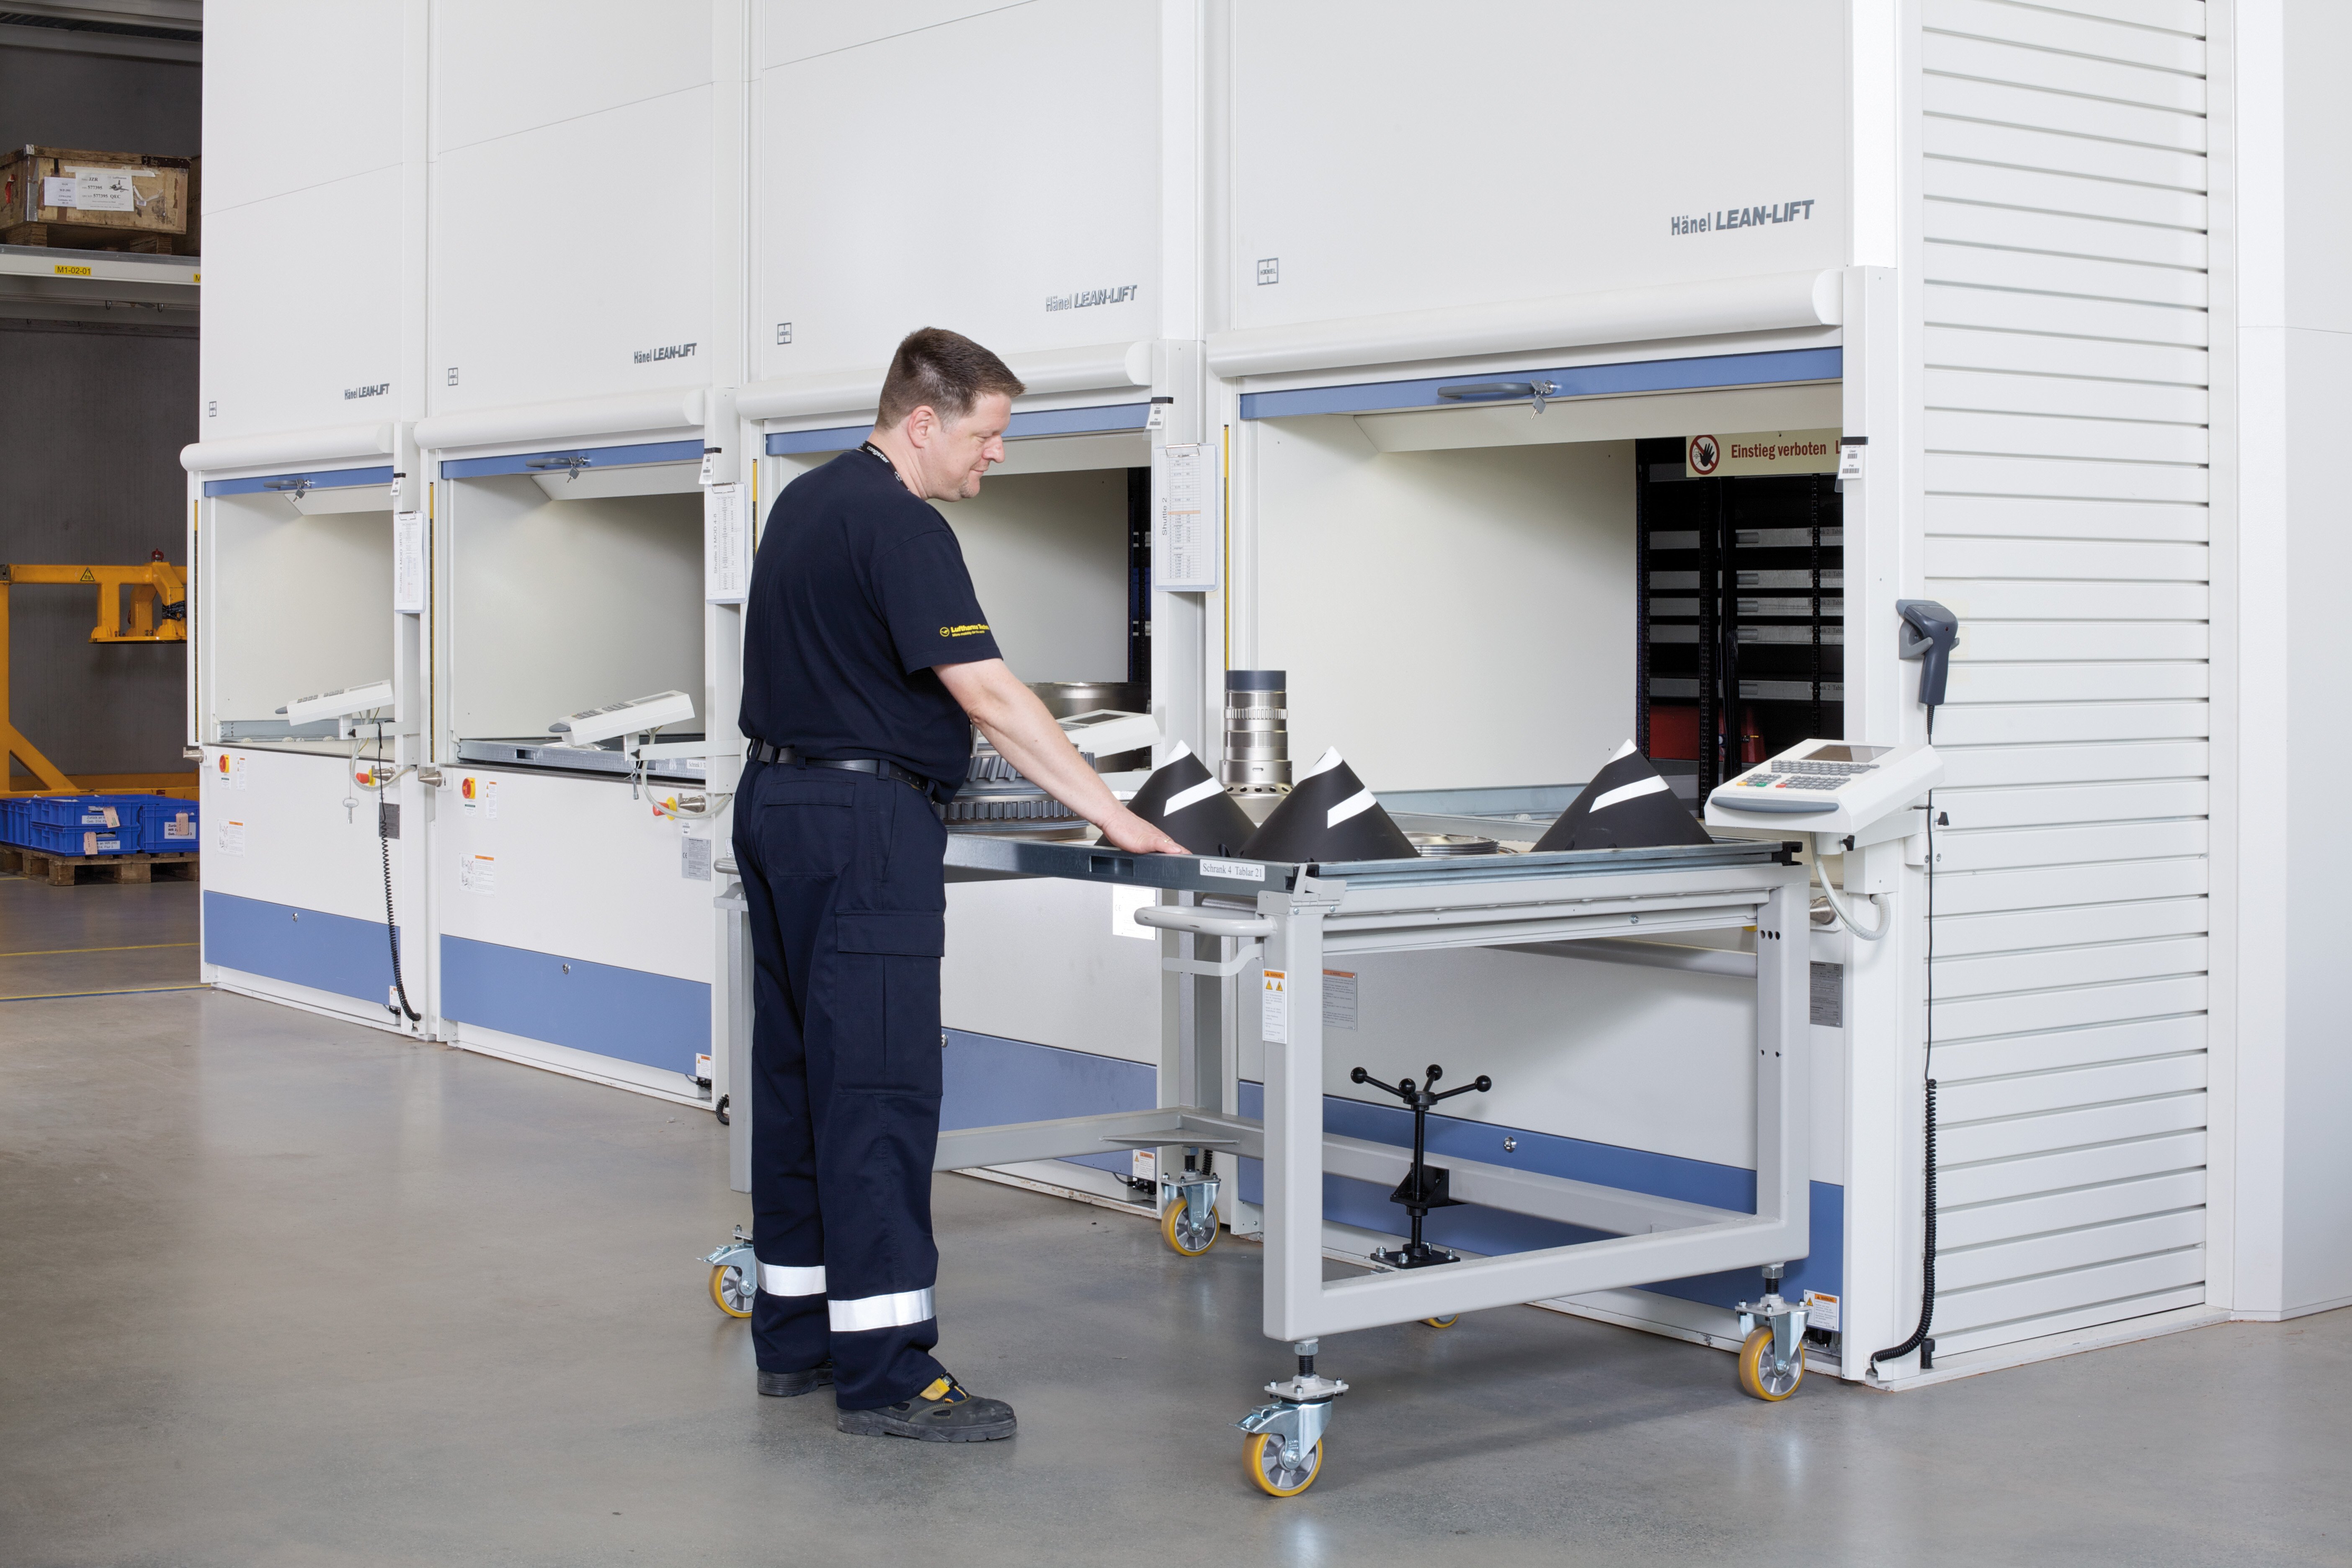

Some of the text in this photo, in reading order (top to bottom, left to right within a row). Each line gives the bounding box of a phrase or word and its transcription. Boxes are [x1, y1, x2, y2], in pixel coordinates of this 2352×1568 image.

[1671, 199, 1815, 235] Hänel LEAN-LIFT
[57, 266, 91, 274] M1-02-01
[1046, 285, 1137, 312] Hänel LEAN-LIFT
[634, 343, 697, 364] Hänel LEAN-LIFT
[345, 383, 390, 400] Hänel LEAN-LIFT
[1731, 443, 1776, 460] Einstieg
[1777, 441, 1826, 456] verboten
[1203, 863, 1262, 877] Schrank 4 Tablar 21
